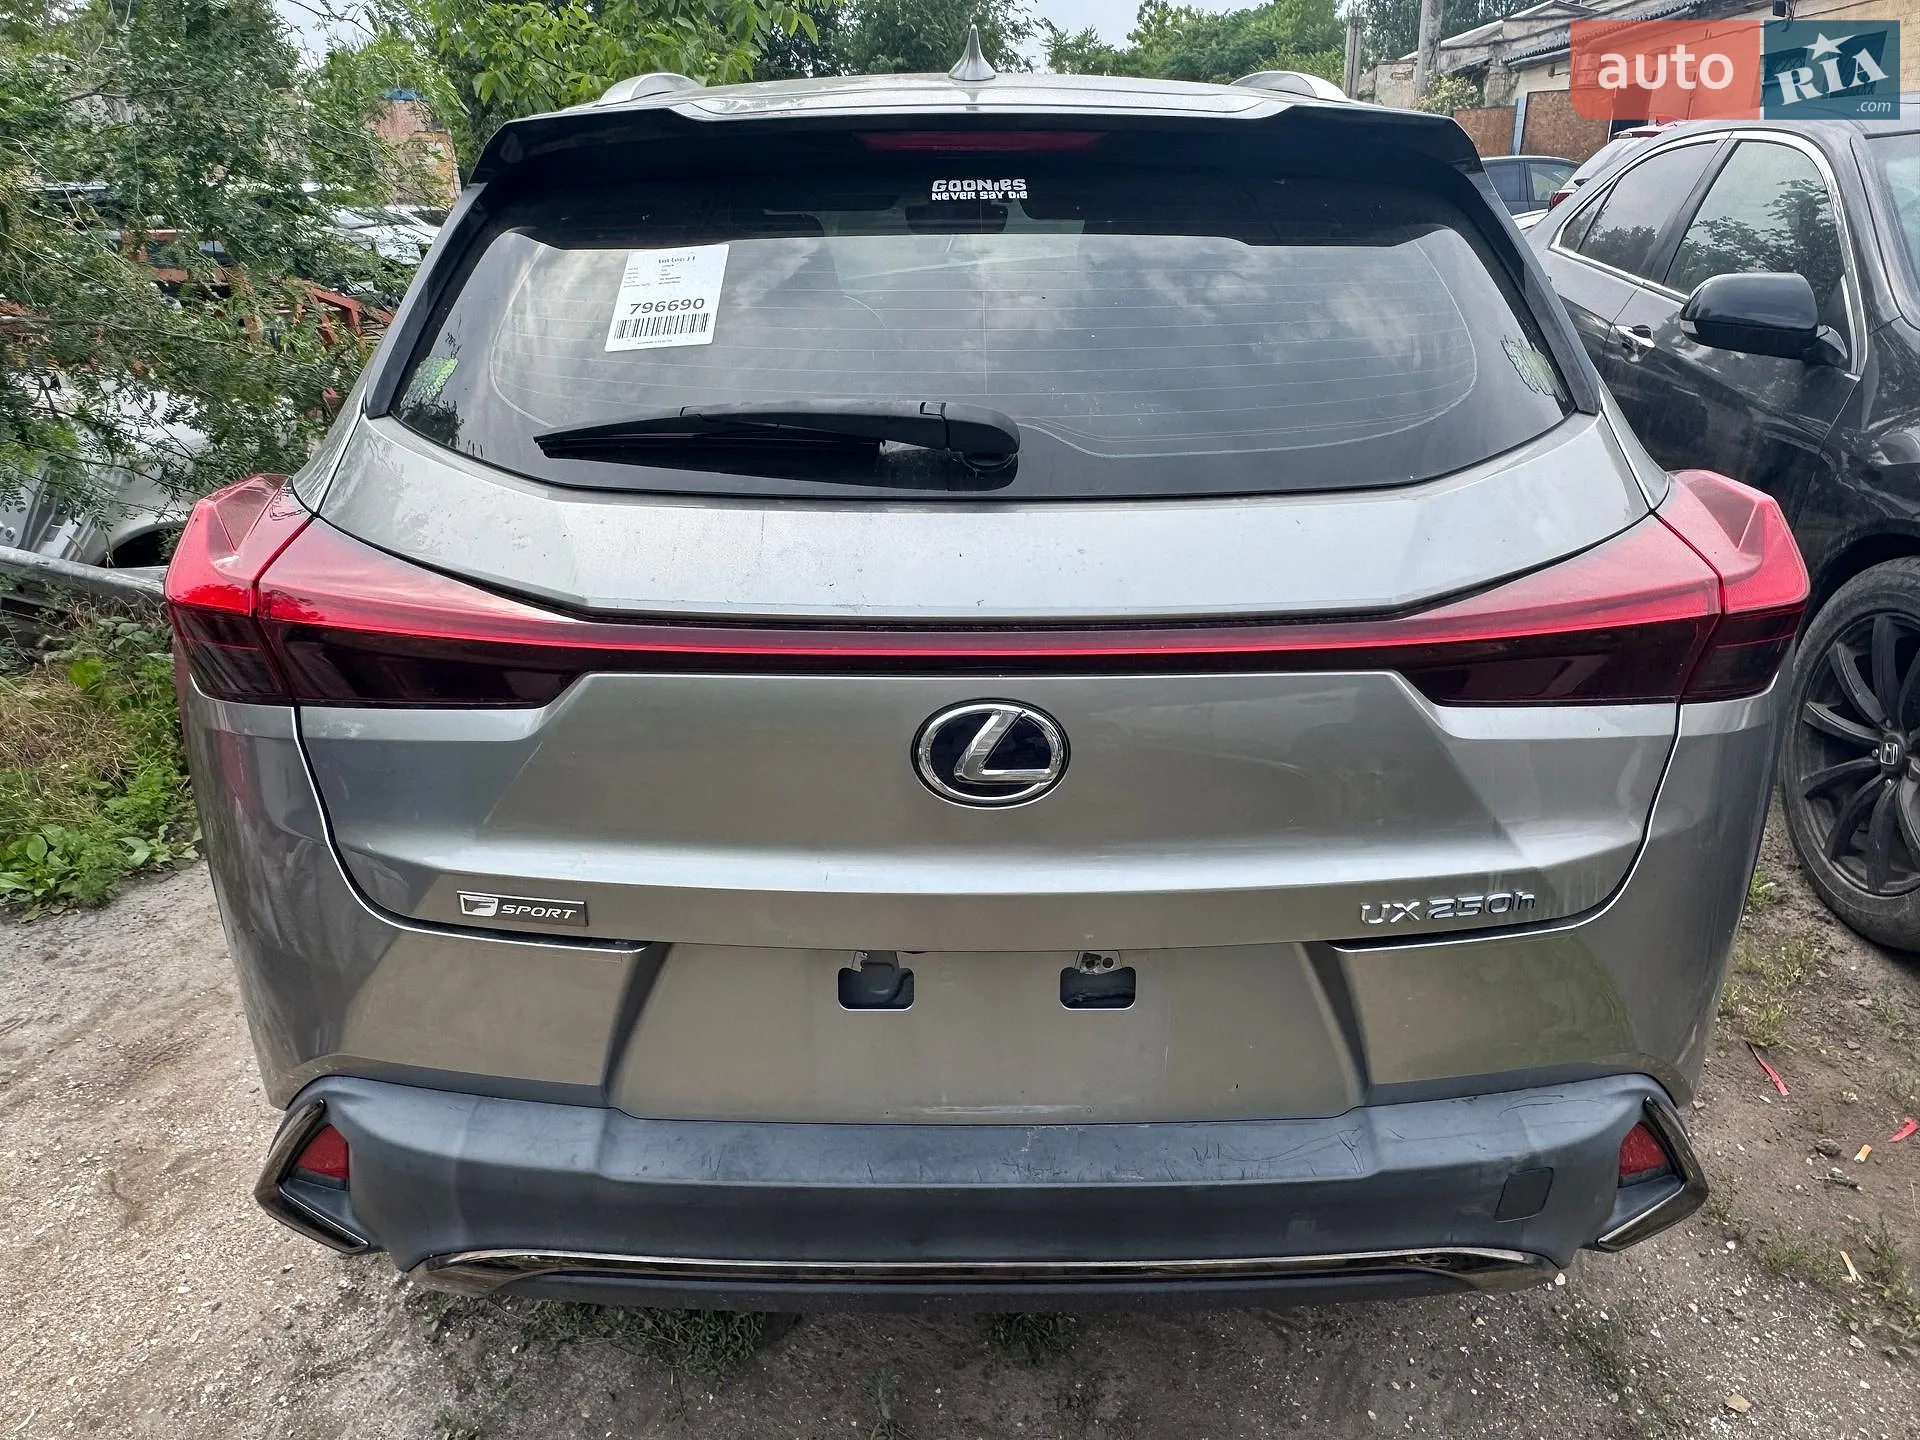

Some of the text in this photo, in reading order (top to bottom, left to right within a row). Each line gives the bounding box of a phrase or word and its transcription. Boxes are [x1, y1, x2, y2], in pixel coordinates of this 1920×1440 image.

[629, 298, 705, 315] 796690
[500, 904, 577, 919] SPORT
[1360, 889, 1536, 925] UX 250h
